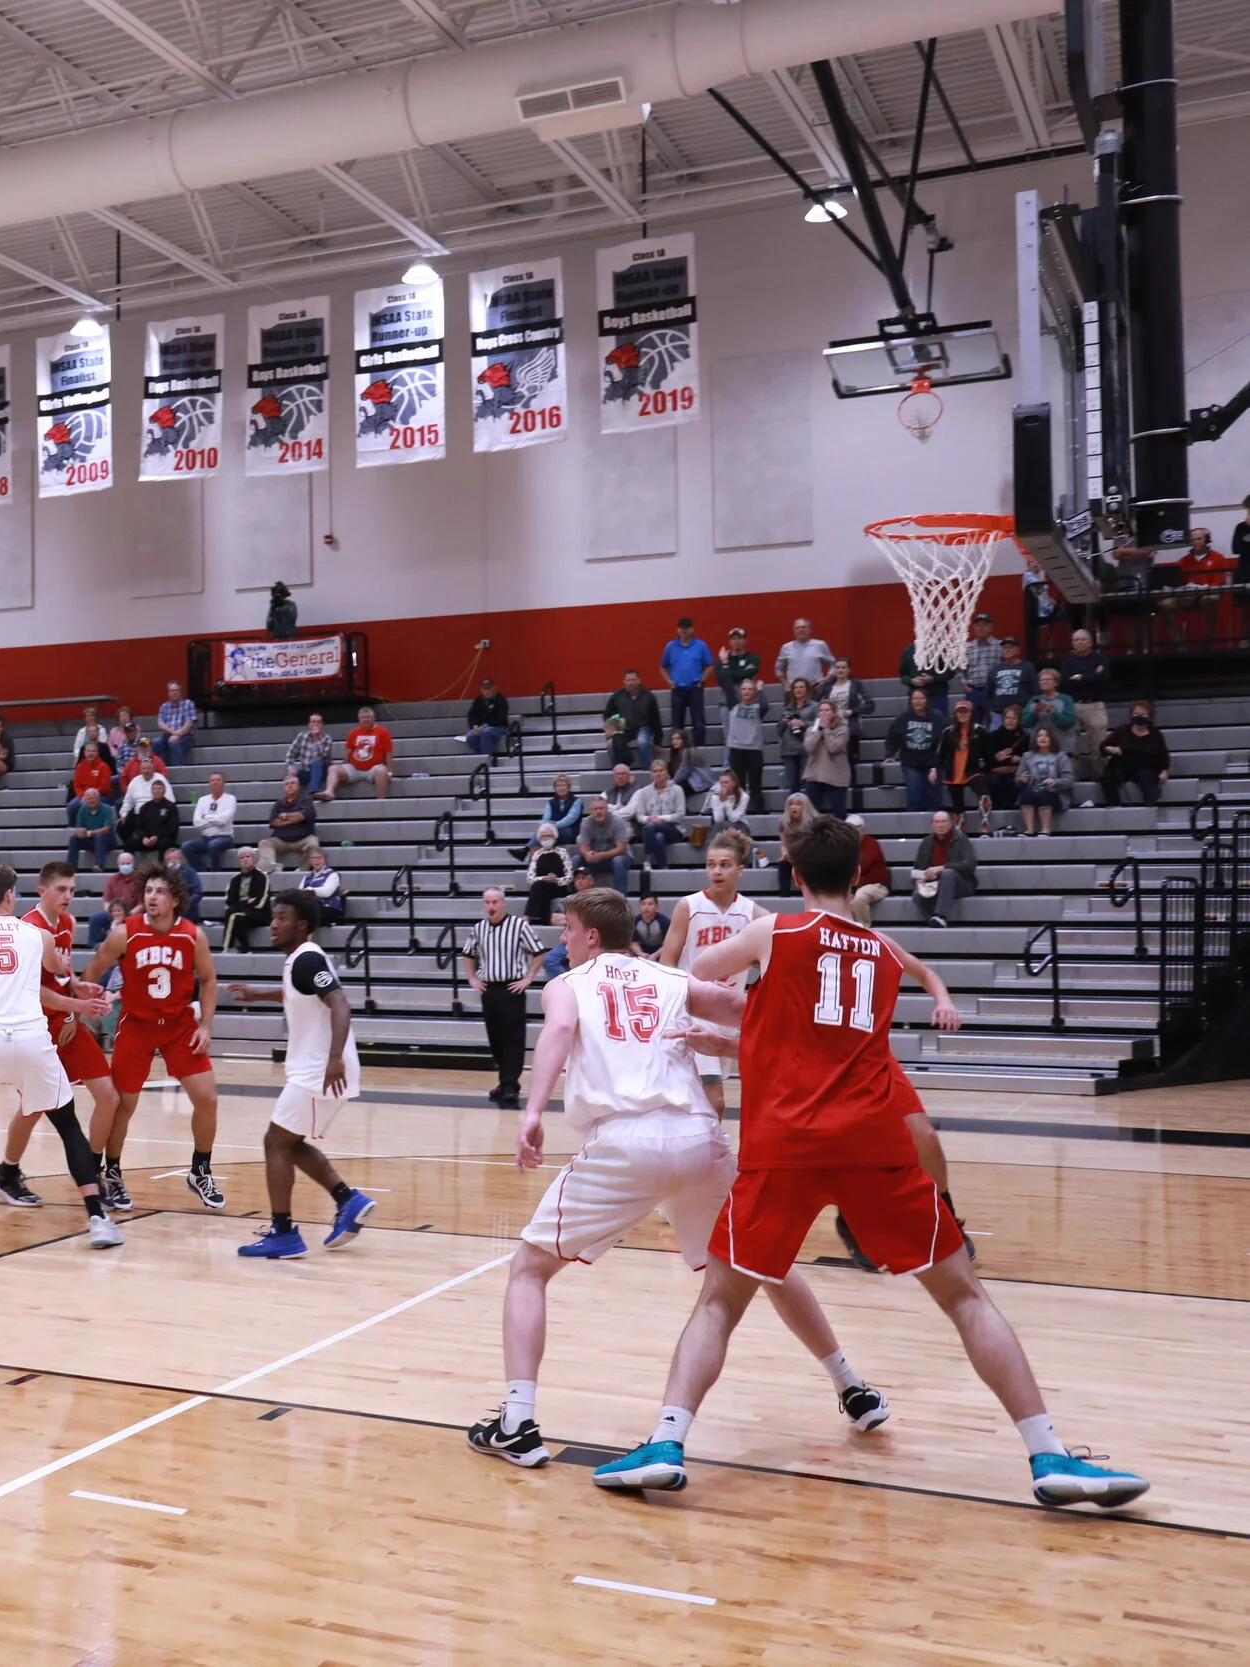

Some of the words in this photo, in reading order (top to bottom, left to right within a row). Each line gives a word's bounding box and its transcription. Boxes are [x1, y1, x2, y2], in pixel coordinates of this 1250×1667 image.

[632, 251, 654, 261] Class
[503, 274, 523, 283] Class
[387, 295, 406, 303] Class
[279, 313, 297, 321] Class
[405, 308, 433, 321] State
[603, 315, 631, 329] Boys
[632, 304, 692, 325] Basketball
[371, 326, 428, 343] Runner-up
[476, 336, 497, 350] Boys
[498, 333, 523, 346] Cross
[525, 325, 560, 342] Country
[79, 355, 105, 368] State
[360, 354, 383, 367] Girls
[384, 344, 439, 363] Basketball
[61, 371, 96, 386] Finalist
[252, 369, 274, 382] Boys
[276, 362, 326, 380] Basketball
[148, 382, 169, 393] Boys
[170, 375, 219, 391] Basketball
[39, 399, 63, 411] Girls
[638, 386, 694, 417] 2019
[509, 406, 562, 434] 2016
[390, 424, 439, 449] 2015
[174, 448, 218, 471] 2010
[278, 438, 323, 463] 2014
[66, 460, 109, 486] 2009
[819, 926, 882, 958] HATTON
[135, 945, 184, 970] HBCA
[147, 967, 172, 999] 3
[814, 952, 876, 1033] 11
[597, 982, 660, 1043] 15
